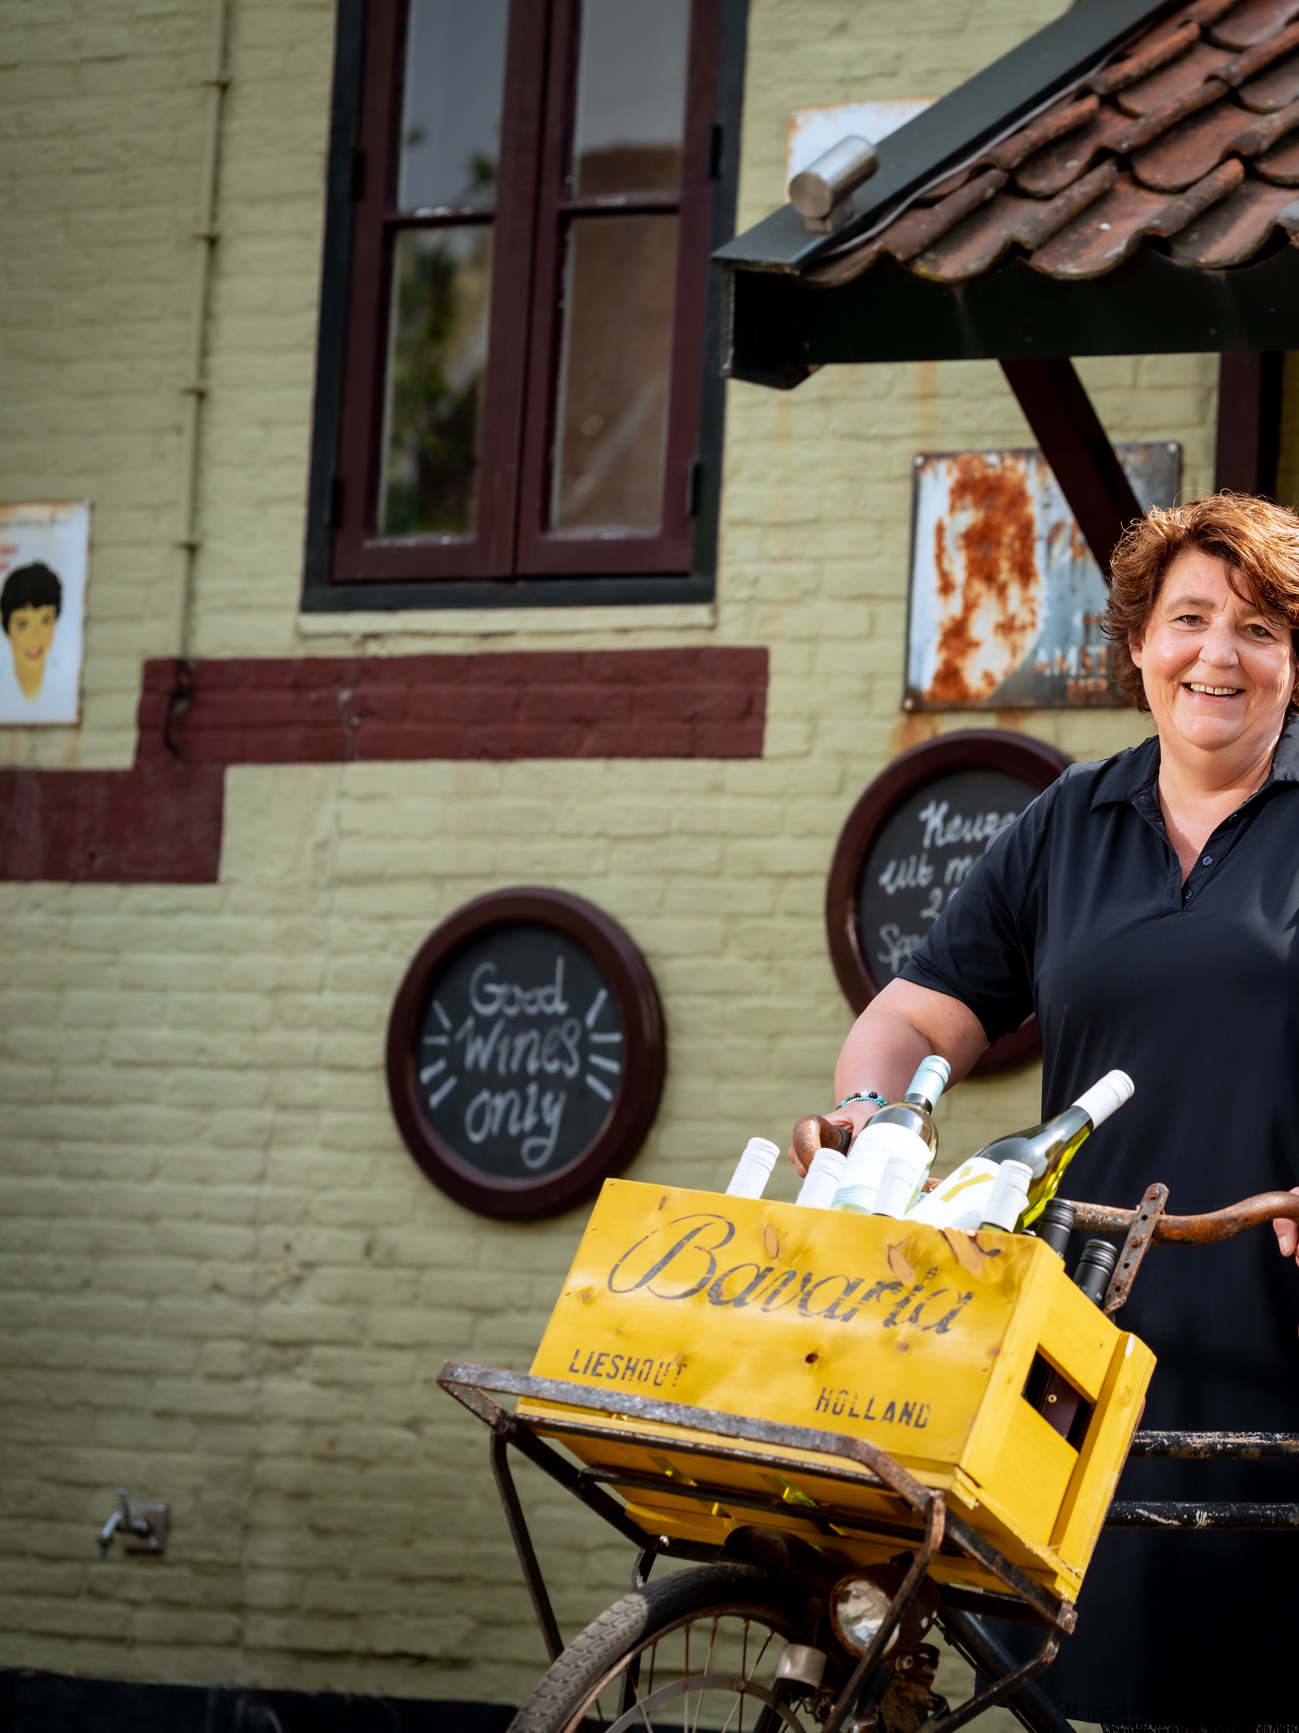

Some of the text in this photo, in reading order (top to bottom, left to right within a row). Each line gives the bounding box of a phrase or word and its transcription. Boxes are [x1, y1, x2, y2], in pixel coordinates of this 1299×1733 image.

[468, 955, 570, 1017] Good
[454, 1014, 583, 1079] Wines
[464, 1082, 568, 1169] only
[607, 1213, 976, 1335] Bavaria
[568, 1348, 688, 1388] LIESHOUT
[814, 1387, 932, 1431] HOLLAND
